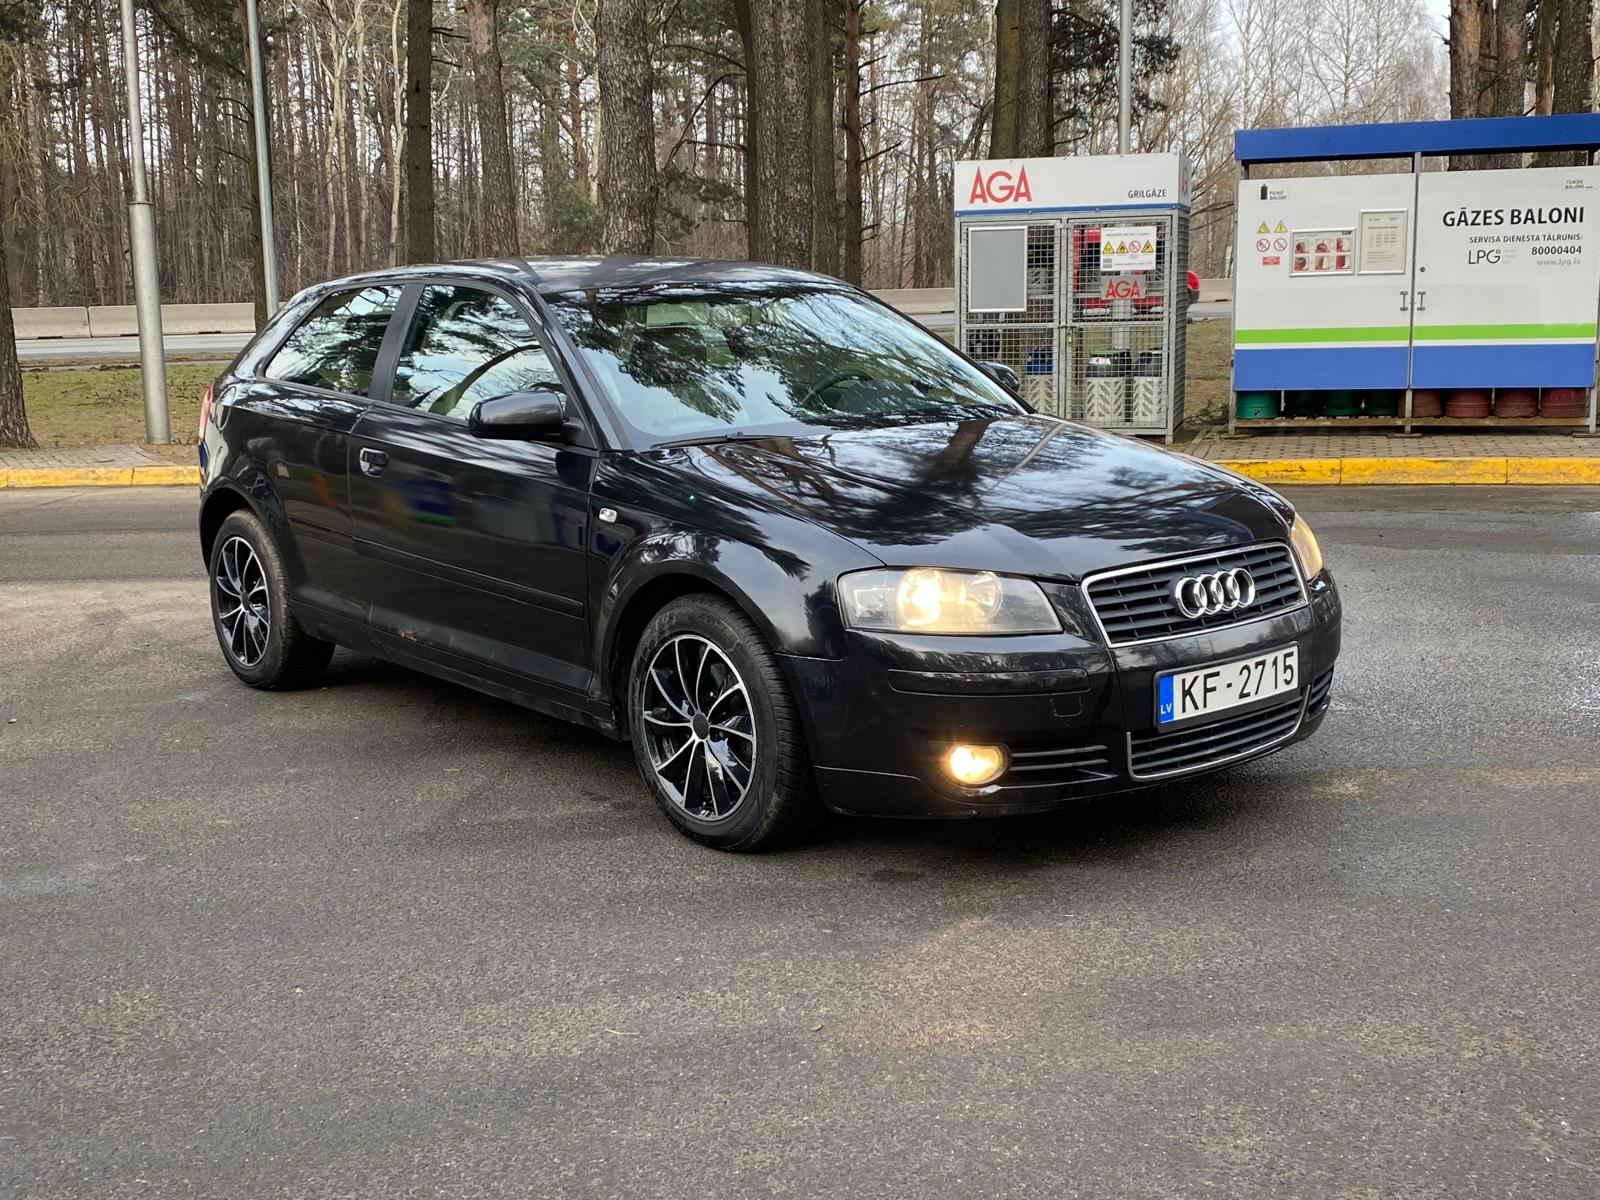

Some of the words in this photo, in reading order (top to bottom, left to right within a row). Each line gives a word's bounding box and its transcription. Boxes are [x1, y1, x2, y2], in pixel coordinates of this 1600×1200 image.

[969, 164, 1032, 204] AGA
[1127, 187, 1167, 199] GRILGĀZE
[1442, 207, 1504, 227] GĀZES
[1510, 207, 1584, 225] BALONI
[1469, 235, 1501, 244] SERVISA
[1503, 234, 1540, 242] DIENESTA
[1542, 232, 1584, 242] TĀLRUNIS:
[1468, 249, 1501, 264] LPG
[1531, 245, 1582, 255] 80000404
[1537, 258, 1581, 267] www.lpg.lv
[1105, 278, 1141, 298] AGA
[1181, 651, 1294, 713] KF-2715
[1160, 703, 1173, 714] LV
